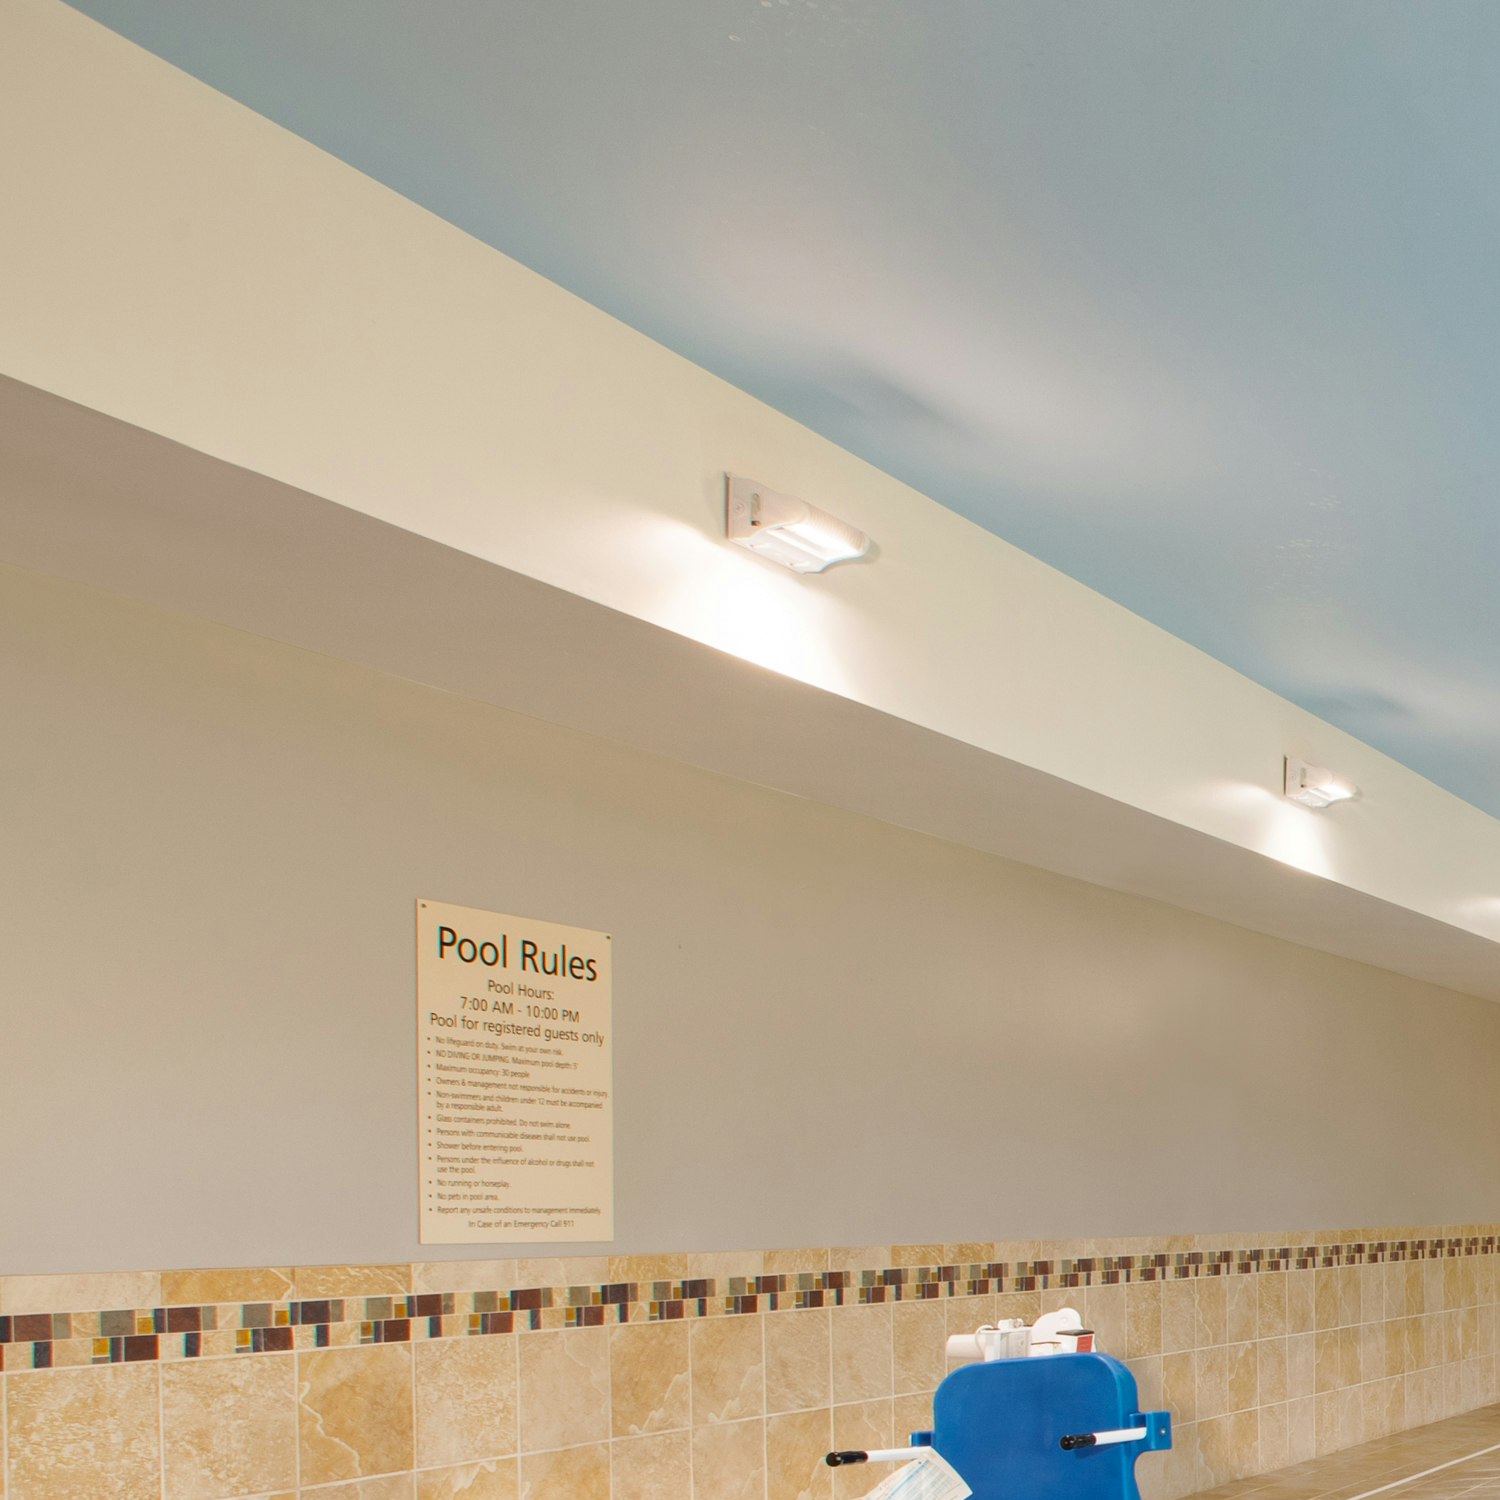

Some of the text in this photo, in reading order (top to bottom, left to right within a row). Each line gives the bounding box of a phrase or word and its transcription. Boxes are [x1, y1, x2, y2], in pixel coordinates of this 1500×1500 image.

[438, 926, 598, 981] Pool Rules
[488, 979, 554, 1000] Pool Hours:
[460, 996, 488, 1011] 7:00
[492, 1001, 514, 1015] AM
[526, 1005, 558, 1020] 10:00
[562, 1009, 580, 1023] PM
[430, 1012, 605, 1047] Pool for registered guests only
[468, 1220, 476, 1228] In
[477, 1220, 493, 1228] Case
[494, 1220, 502, 1228] of
[514, 1220, 549, 1230] Emergency
[550, 1220, 562, 1228] Call
[564, 1220, 574, 1228] 911
